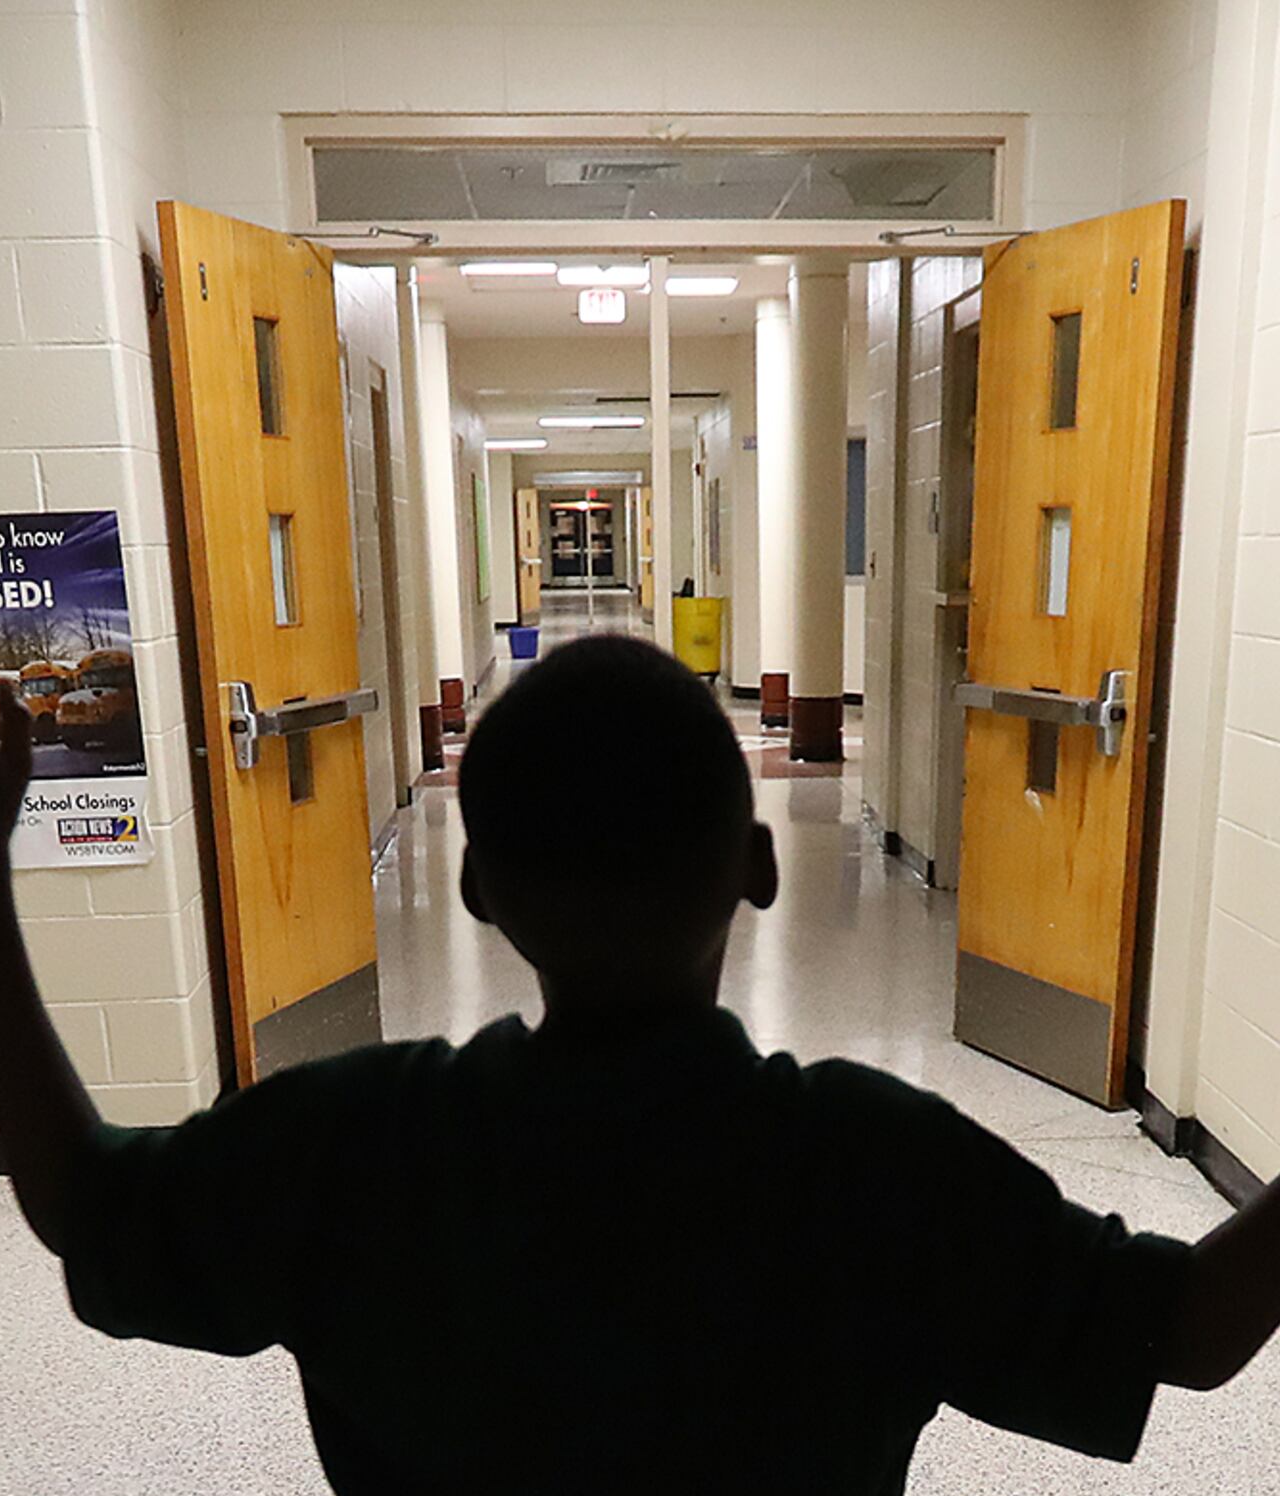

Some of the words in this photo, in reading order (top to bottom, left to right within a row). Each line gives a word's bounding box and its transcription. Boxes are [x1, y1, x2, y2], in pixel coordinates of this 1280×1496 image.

[11, 523, 65, 547] know
[9, 552, 25, 573] is
[24, 794, 72, 811] School
[75, 793, 136, 812] Closings
[117, 815, 138, 842] 2
